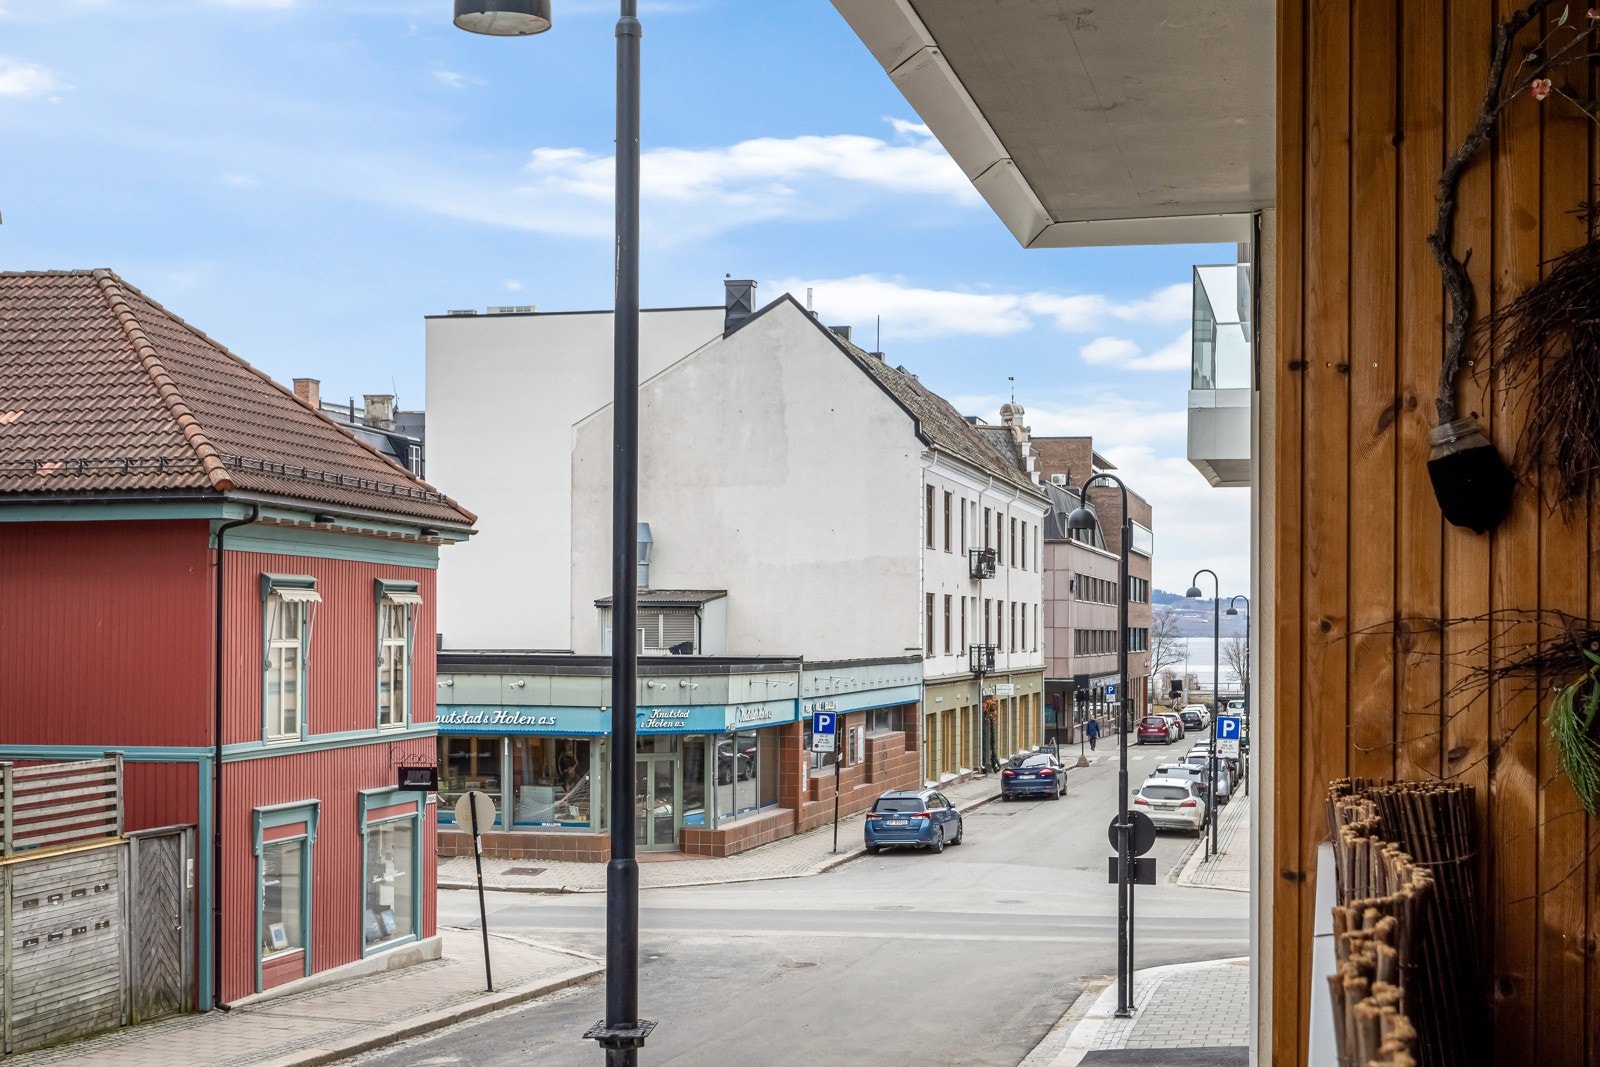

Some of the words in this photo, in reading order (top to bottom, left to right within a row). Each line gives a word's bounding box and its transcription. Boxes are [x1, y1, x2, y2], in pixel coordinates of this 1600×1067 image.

[1108, 686, 1114, 694] P
[436, 710, 484, 724] nutstad
[490, 710, 536, 725] Holen
[650, 708, 690, 718] Knutstad
[646, 719, 673, 728] Holen
[818, 715, 831, 732] P
[1222, 720, 1235, 737] P
